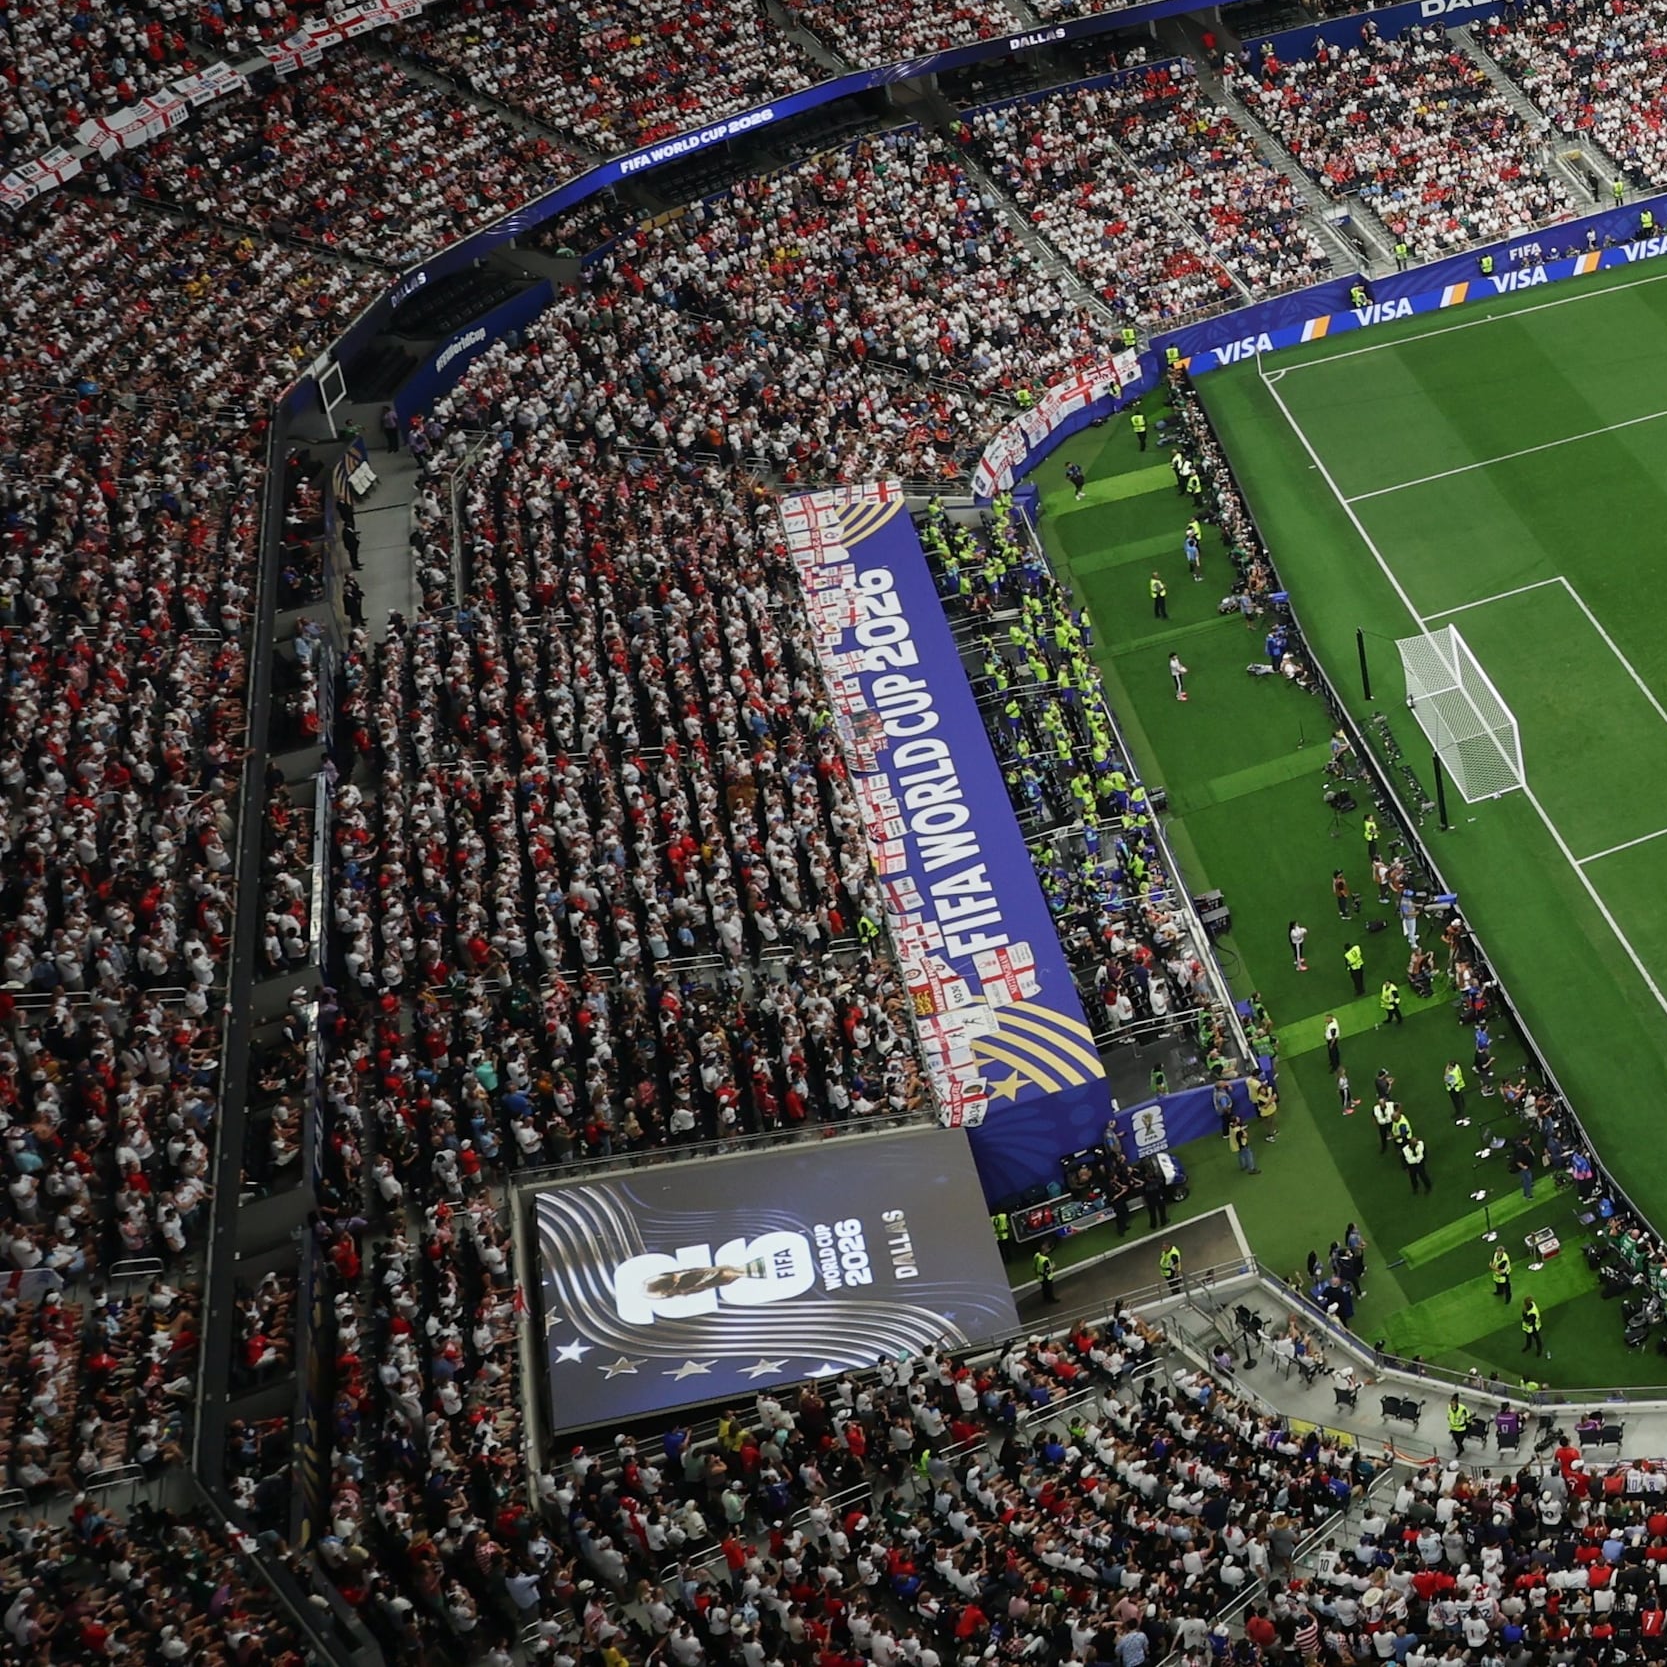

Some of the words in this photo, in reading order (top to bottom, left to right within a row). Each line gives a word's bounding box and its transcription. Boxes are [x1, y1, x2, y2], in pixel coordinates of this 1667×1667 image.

[1009, 28, 1065, 50] DALLAS
[621, 153, 650, 174] FIFA
[652, 137, 698, 163] WORLD
[700, 125, 727, 144] CUP
[729, 108, 774, 133] 2026
[1508, 242, 1541, 261] FIFA
[1350, 297, 1413, 327] VISA
[436, 328, 487, 373] #FIFAWorldCup
[1211, 332, 1274, 366] VISA
[854, 567, 920, 671] 2026
[872, 673, 940, 738] CUP
[893, 738, 980, 872] WORLD
[930, 862, 1009, 959] FIFA
[814, 1223, 833, 1248] CUP
[842, 1218, 873, 1288] 2026
[881, 1208, 919, 1280] DALLAS
[775, 1248, 795, 1280] FIFA
[821, 1247, 842, 1291] WORLD
[1318, 1558, 1329, 1572] 10
[1645, 1616, 1654, 1630] 7
